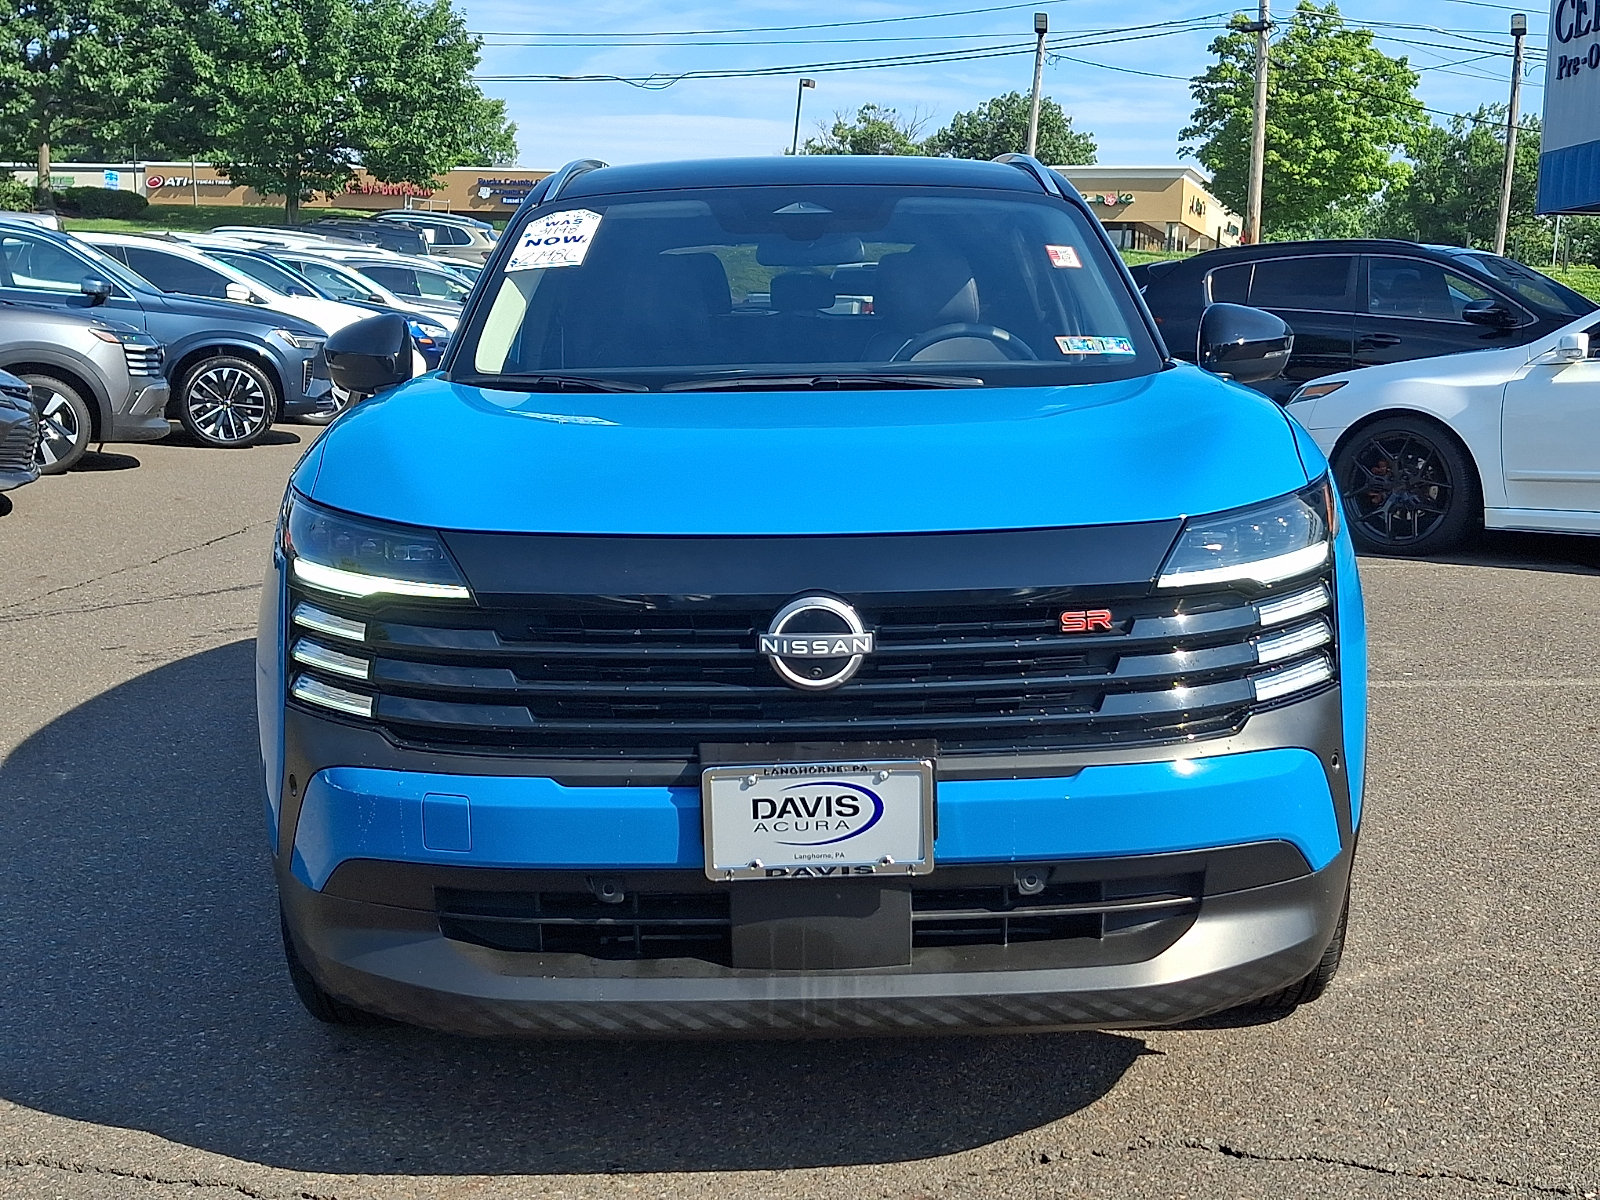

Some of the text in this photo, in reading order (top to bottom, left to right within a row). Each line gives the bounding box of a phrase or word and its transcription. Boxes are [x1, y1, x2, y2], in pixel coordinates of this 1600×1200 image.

[164, 176, 189, 187] ATI
[545, 218, 583, 227] WAS
[525, 235, 584, 247] NOW
[1061, 610, 1112, 632] SR
[761, 637, 870, 655] NISSAN
[752, 795, 860, 820] DAVIS
[754, 819, 851, 833] ACURA
[794, 852, 834, 860] Langhorne,
[765, 865, 875, 877] DAVIS
